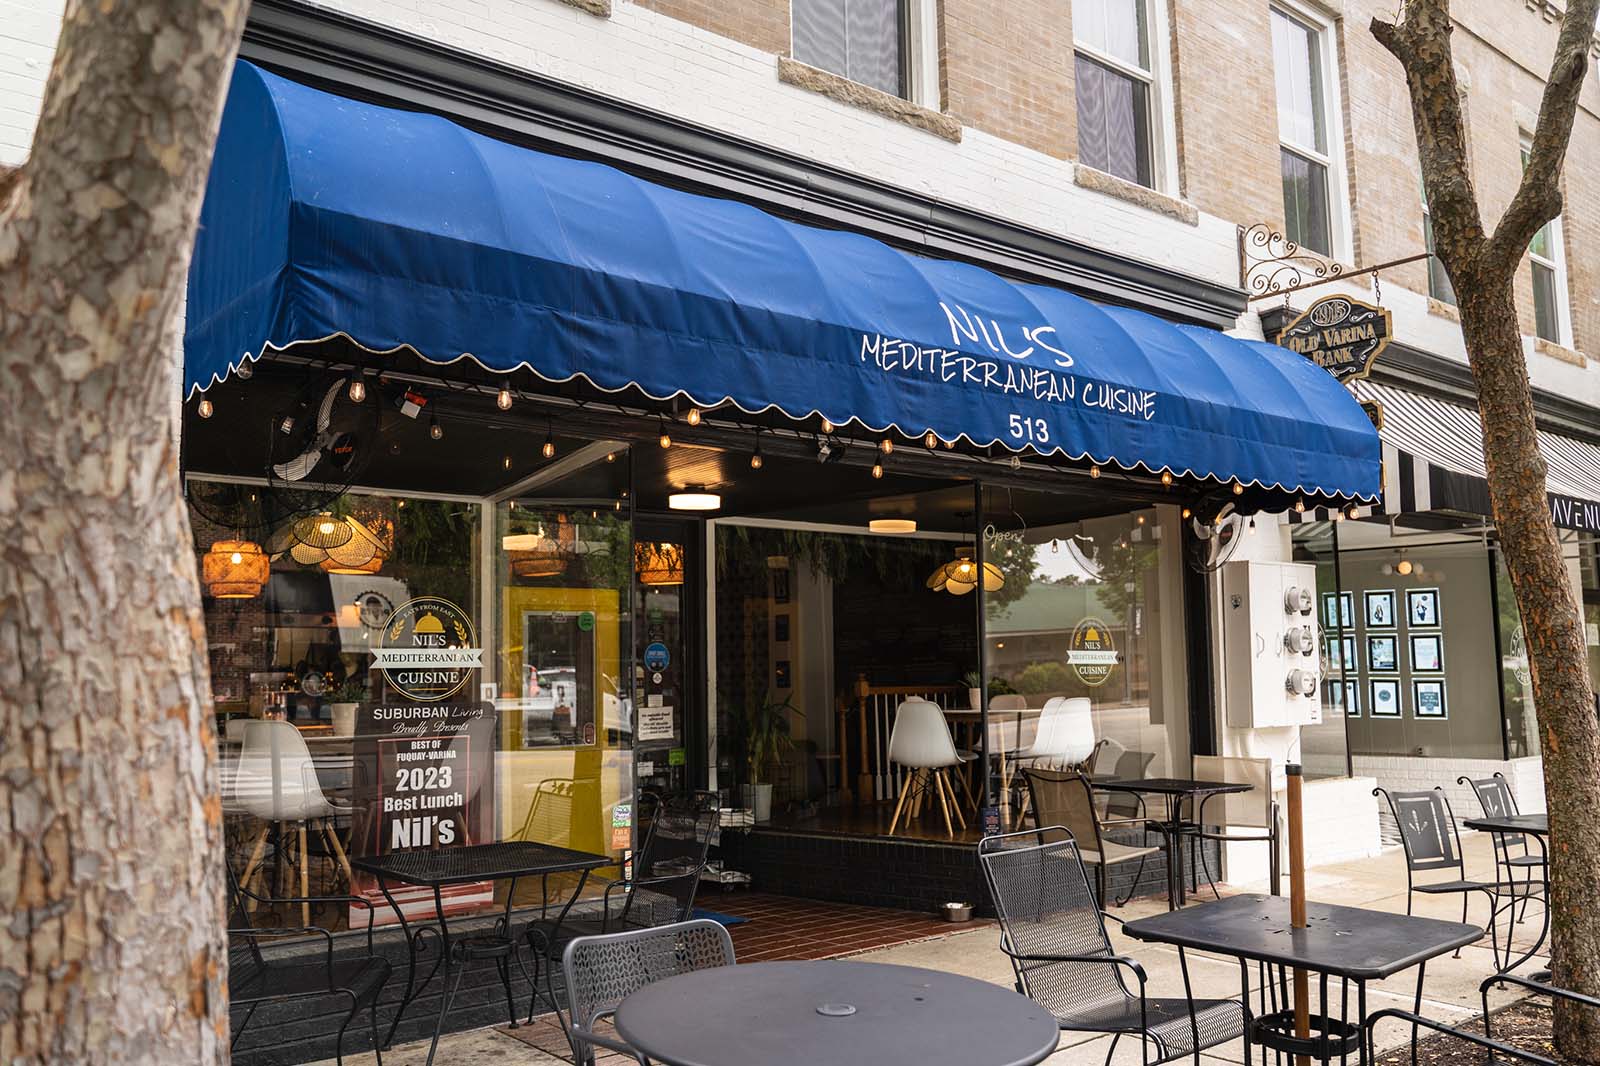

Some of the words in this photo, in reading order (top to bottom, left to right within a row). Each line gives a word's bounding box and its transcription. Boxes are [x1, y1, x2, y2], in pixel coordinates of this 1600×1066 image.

[939, 301, 1074, 367] NIL'S
[1289, 336, 1319, 353] OLD
[1312, 346, 1355, 367] BANK
[860, 333, 1076, 403] MEDITERRANEAN
[1082, 382, 1158, 421] CUISINE
[1008, 413, 1050, 443] 513
[983, 524, 1021, 545] Open
[412, 634, 447, 647] NIL'S
[397, 671, 460, 684] CUISINE
[1080, 666, 1107, 675] CUISINE
[373, 706, 449, 720] SUBURBAN
[451, 706, 484, 720] Living
[392, 720, 429, 737] Proudly
[432, 720, 469, 733] Presents
[411, 740, 431, 750] BEST
[431, 739, 442, 749] OF
[396, 750, 457, 762] FUQUAY-VARINA
[395, 766, 452, 792] 2023
[384, 795, 418, 812] Best
[420, 792, 463, 809] Lunch
[391, 815, 455, 849] Nil's
